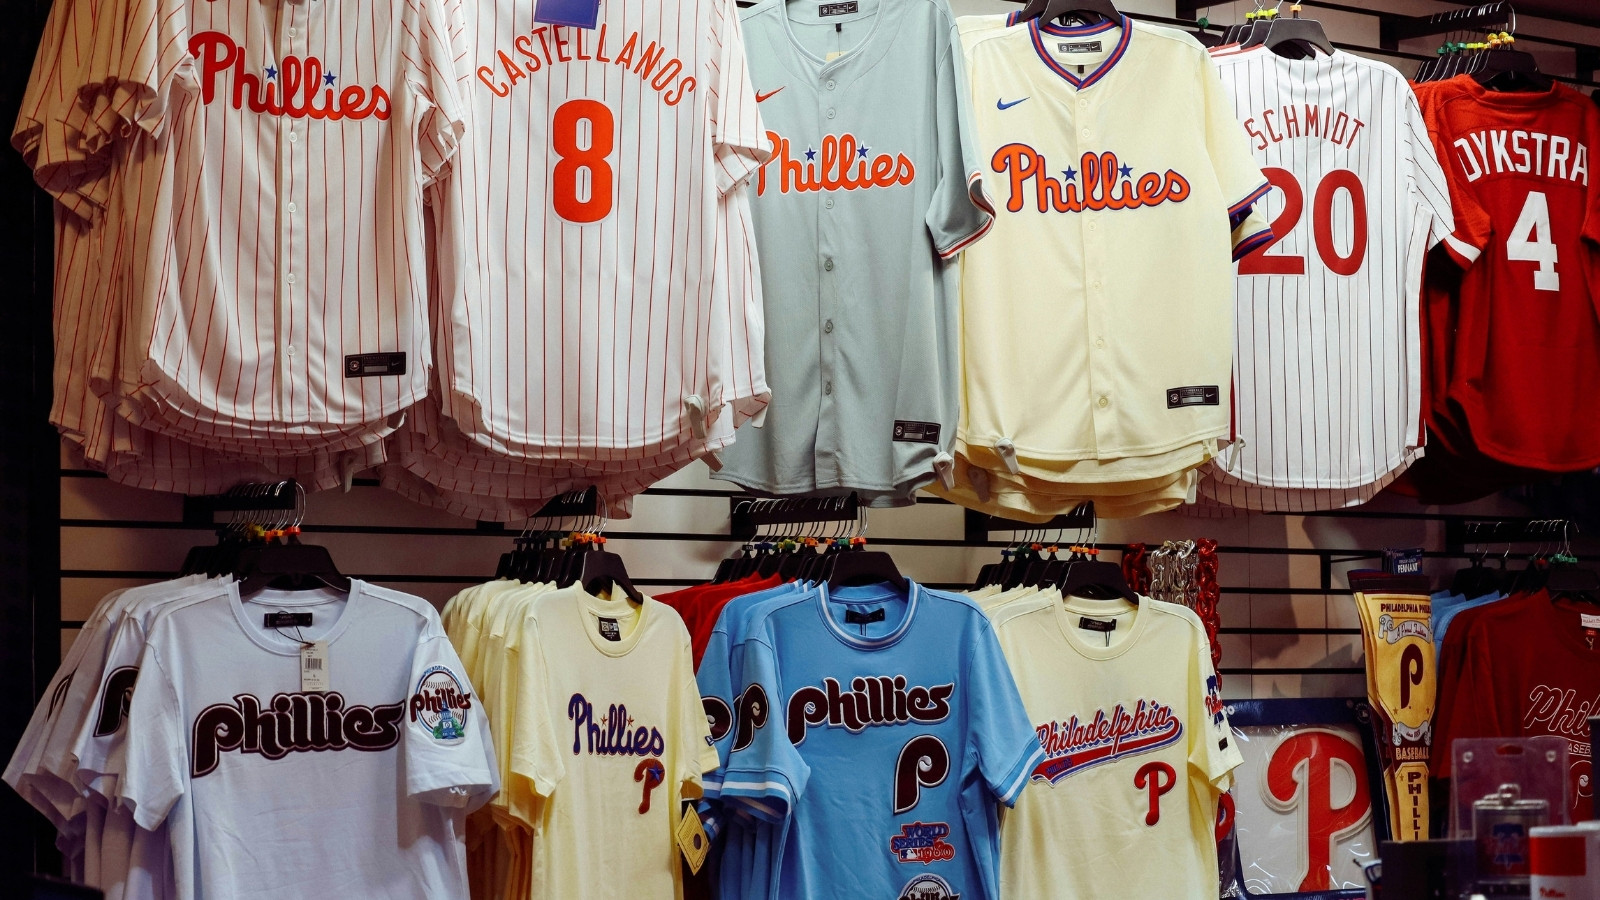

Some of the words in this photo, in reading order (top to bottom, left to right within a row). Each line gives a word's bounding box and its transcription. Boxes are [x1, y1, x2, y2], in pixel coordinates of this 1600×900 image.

[187, 30, 392, 121] Phillies
[476, 23, 697, 107] CASTELLANOS
[1243, 103, 1365, 151] SCHMIDT
[1453, 129, 1589, 187] DYKSTRA
[551, 97, 616, 226] 8
[991, 143, 1191, 213] Phillies
[1236, 166, 1368, 276] 20
[1506, 190, 1560, 292] 4
[1397, 562, 1418, 573] PENNANT
[1380, 603, 1418, 613] PHILADELPHIA
[568, 692, 665, 758] Phillies
[1036, 697, 1175, 758] Philadelphia
[1395, 747, 1430, 760] BASEBALL
[632, 757, 666, 815] P
[1133, 761, 1177, 827] P
[1263, 727, 1373, 893] P
[893, 837, 934, 851] SERIES
[906, 824, 947, 838] WORLD
